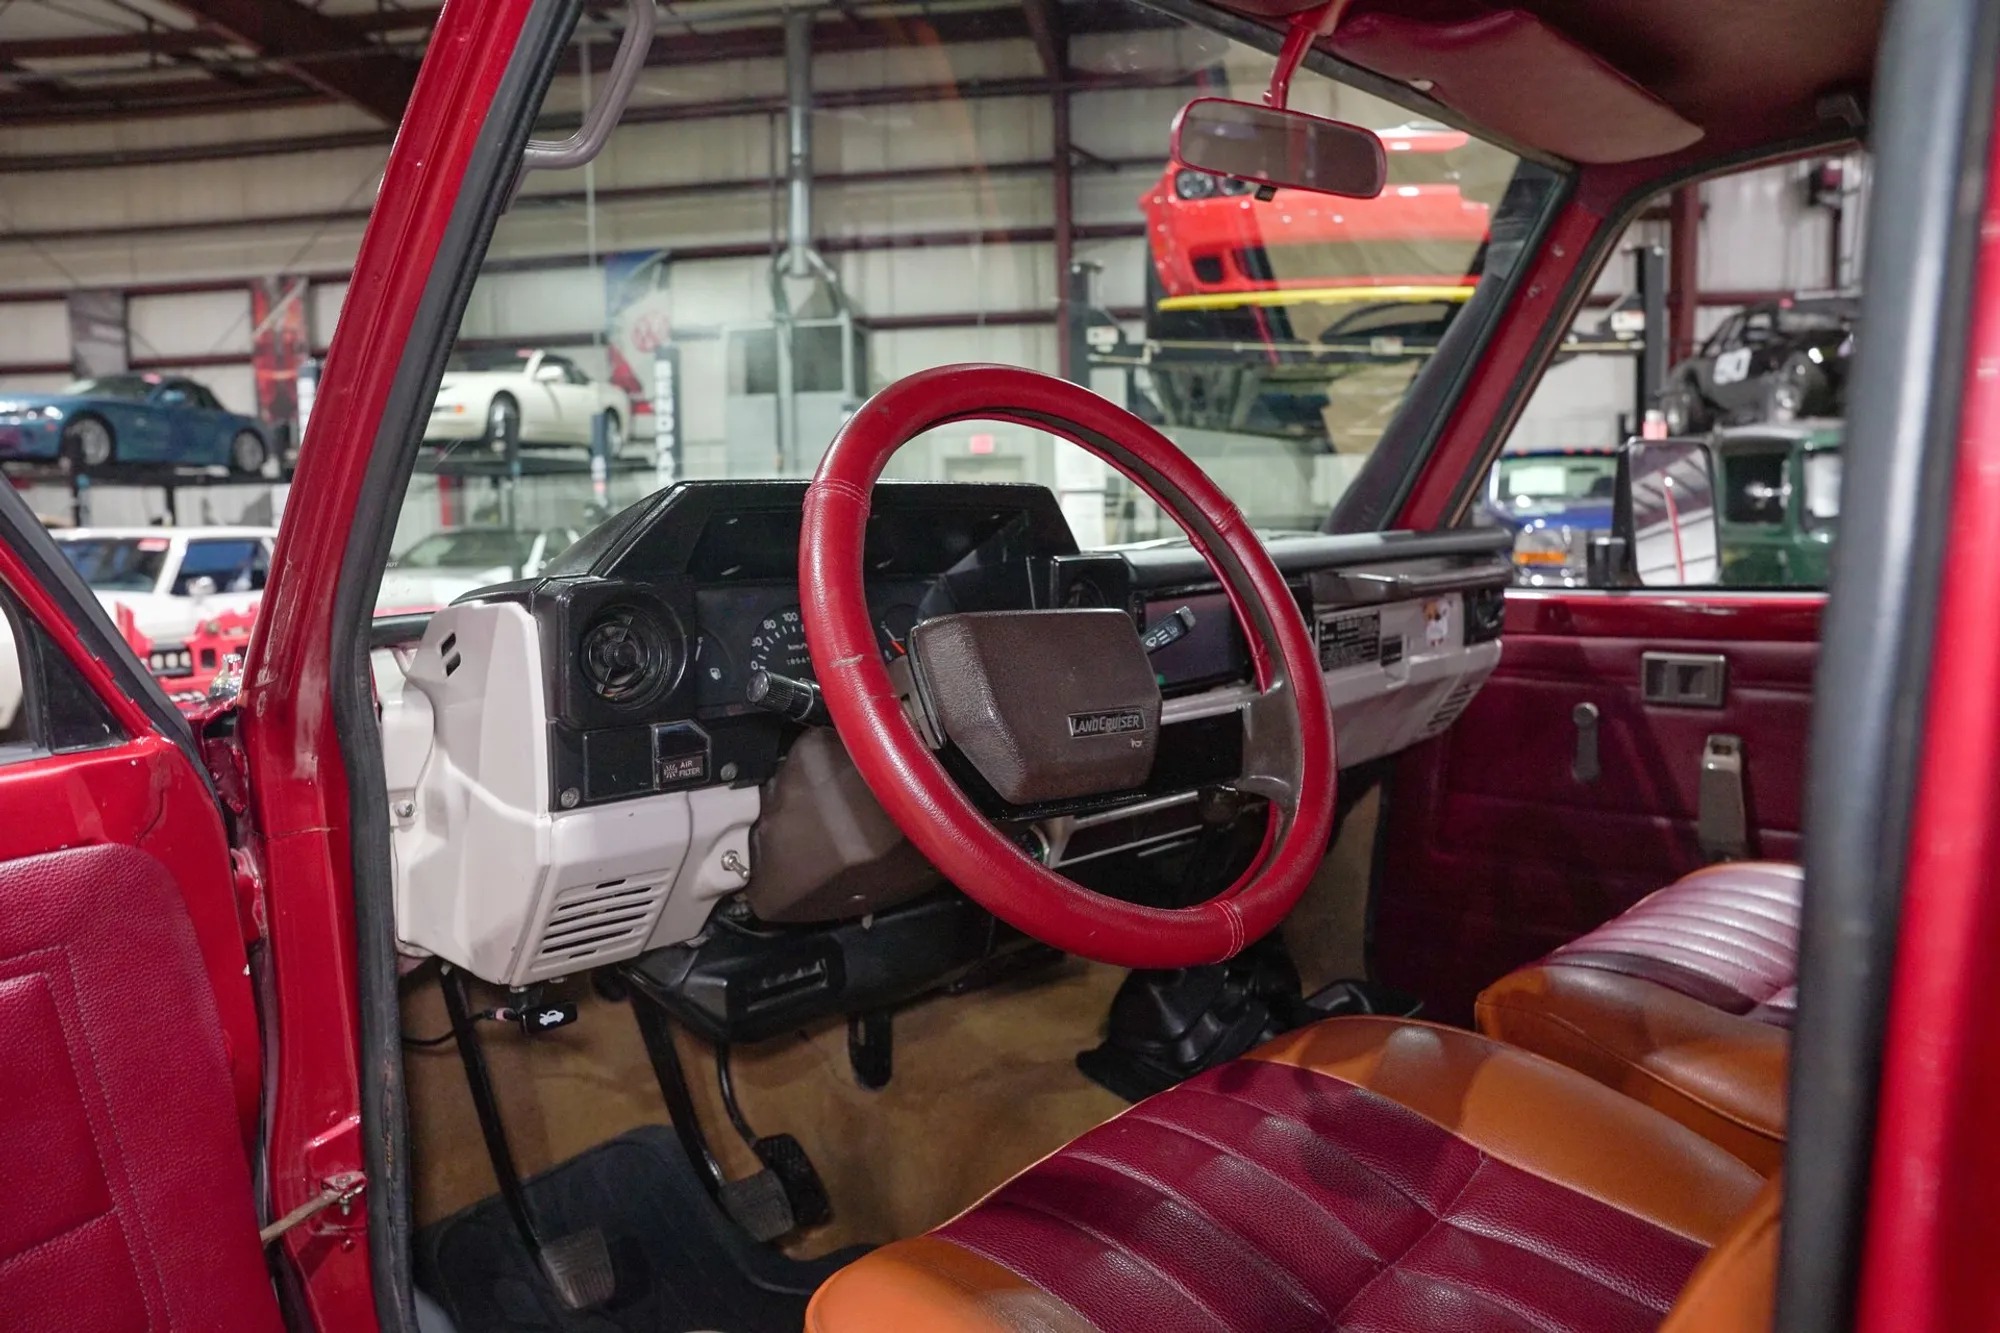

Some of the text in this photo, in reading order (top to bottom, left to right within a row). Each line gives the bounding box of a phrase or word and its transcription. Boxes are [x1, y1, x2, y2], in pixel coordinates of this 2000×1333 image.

[782, 612, 798, 622] 100
[763, 619, 777, 630] 80
[680, 760, 693, 769] AIR
[679, 766, 701, 777] FILTER
